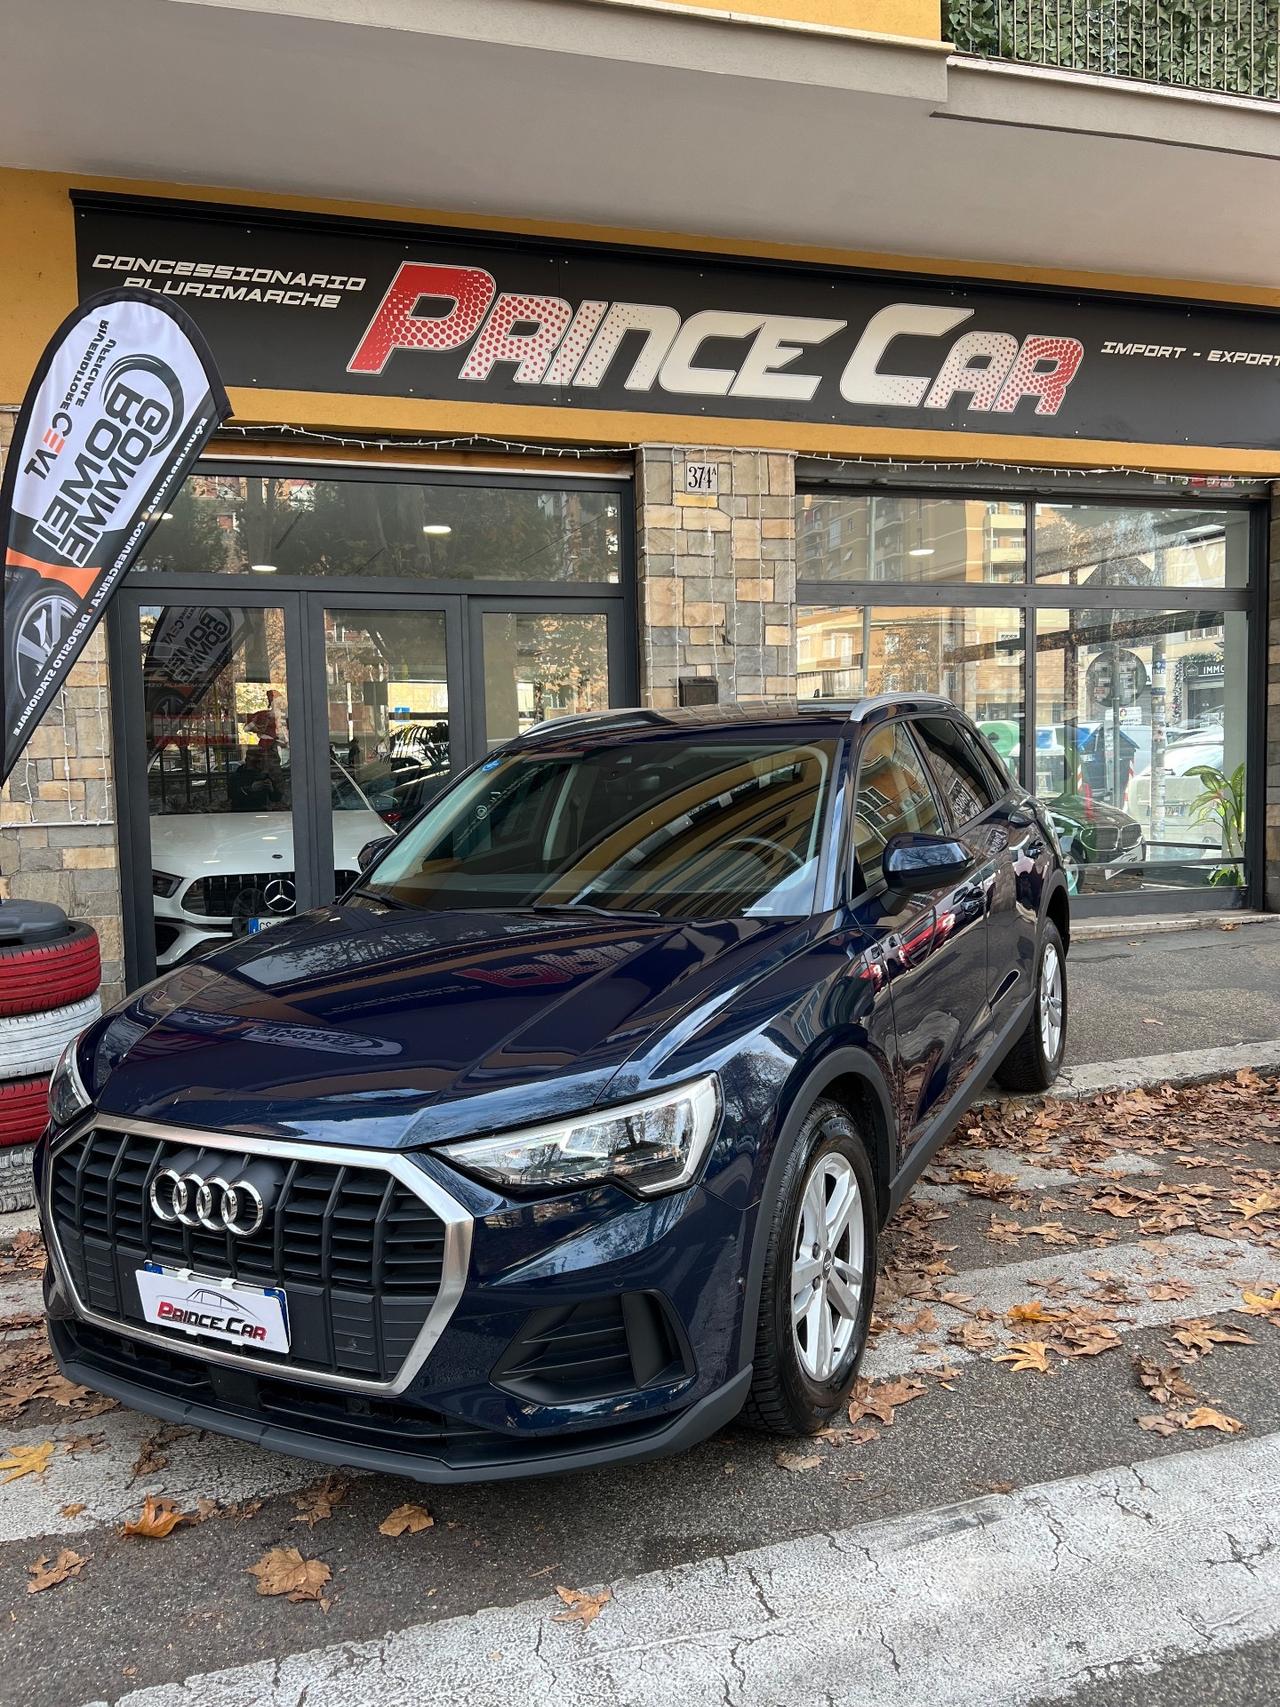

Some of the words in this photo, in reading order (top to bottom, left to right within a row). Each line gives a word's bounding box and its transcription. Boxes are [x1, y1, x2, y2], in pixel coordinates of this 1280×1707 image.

[92, 254, 367, 291] CONCESSIONARIO
[346, 260, 847, 401] PRINCE
[840, 302, 1084, 416] CAR
[1100, 341, 1187, 359] IMPORT
[157, 1301, 225, 1331] PRINCE
[226, 1317, 268, 1342] CAR
